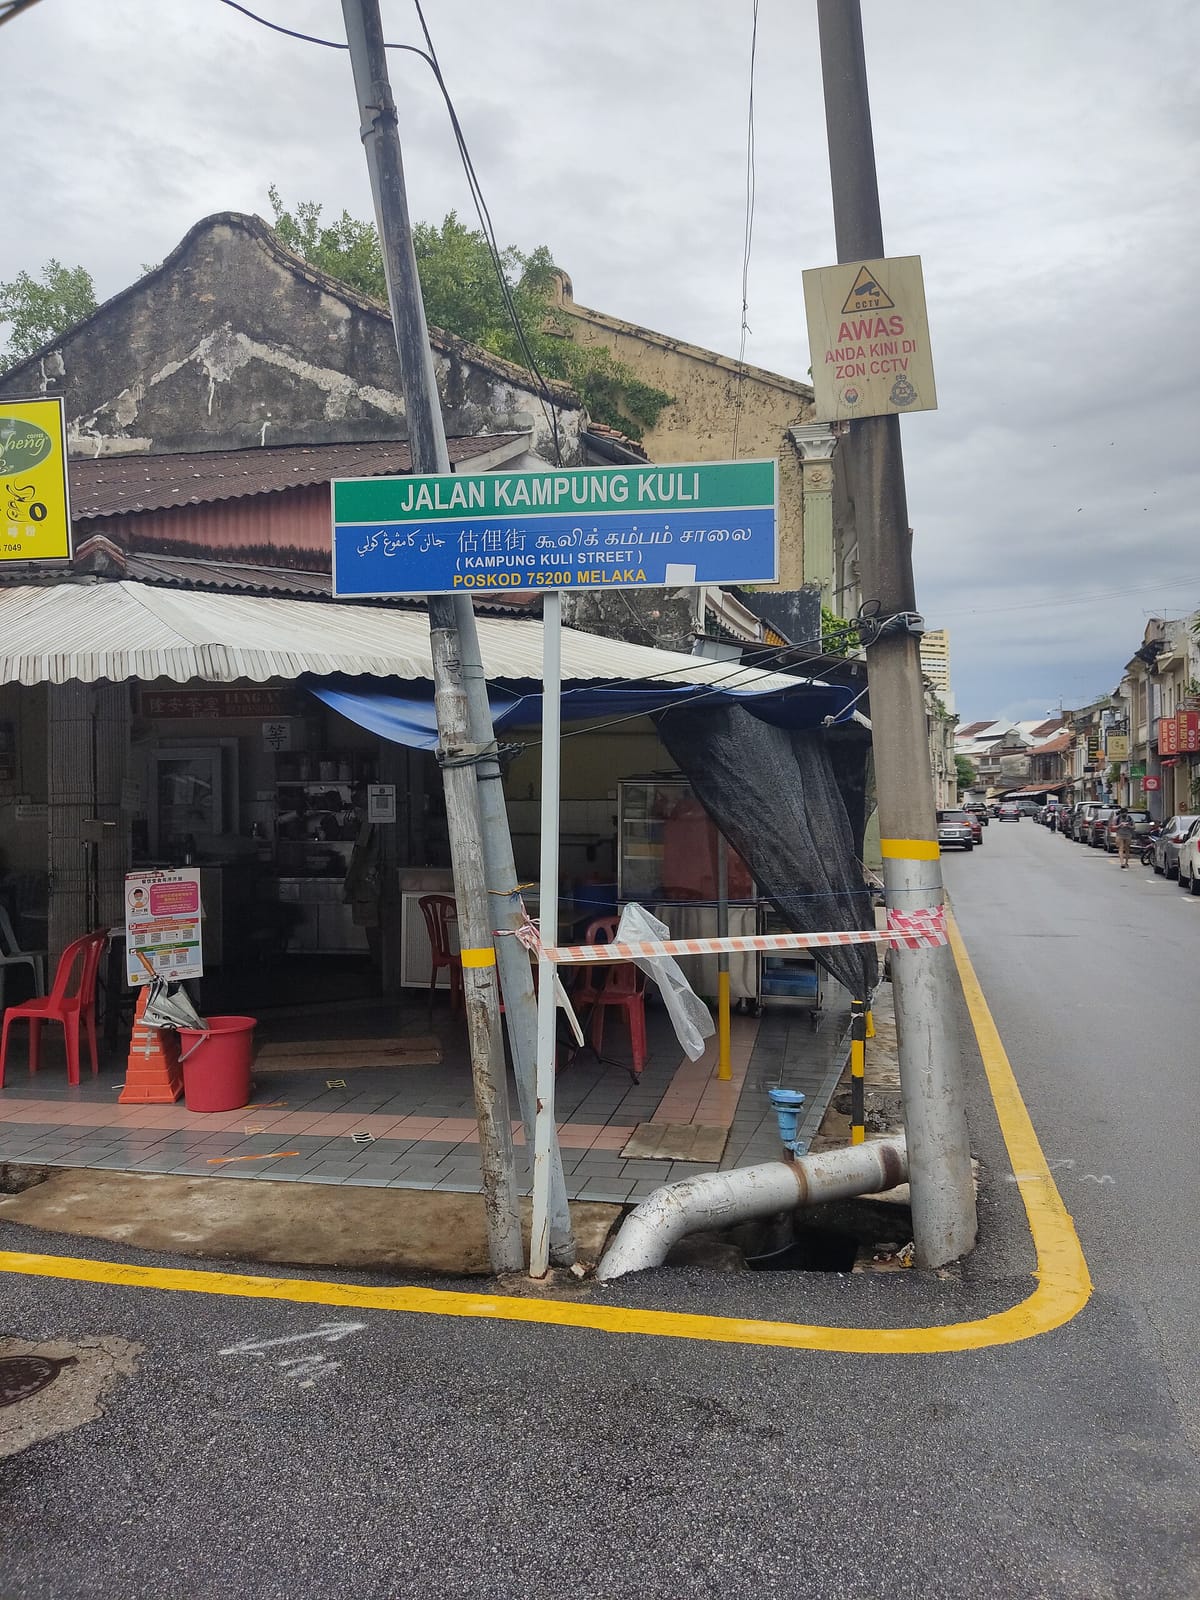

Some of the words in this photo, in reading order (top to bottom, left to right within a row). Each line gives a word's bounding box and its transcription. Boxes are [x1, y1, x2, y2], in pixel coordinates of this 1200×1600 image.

[855, 299, 880, 309] CCTV
[837, 315, 905, 343] AWAS
[825, 345, 866, 364] ANDA
[869, 340, 898, 357] KINI
[902, 339, 917, 353] DI
[835, 363, 866, 380] ZON
[870, 358, 909, 375] CCTV
[400, 480, 486, 512] JALAN
[494, 474, 629, 507] KAMPUNG
[637, 472, 700, 502] KULI
[456, 528, 527, 554] 估俚街
[535, 527, 599, 549] கூலிக்
[604, 524, 673, 546] கம்பம்
[540, 552, 573, 565] KULI
[453, 573, 522, 587] POSKOD
[526, 571, 572, 585] 75200
[577, 569, 647, 583] MELAKA
[265, 725, 287, 750] 等
